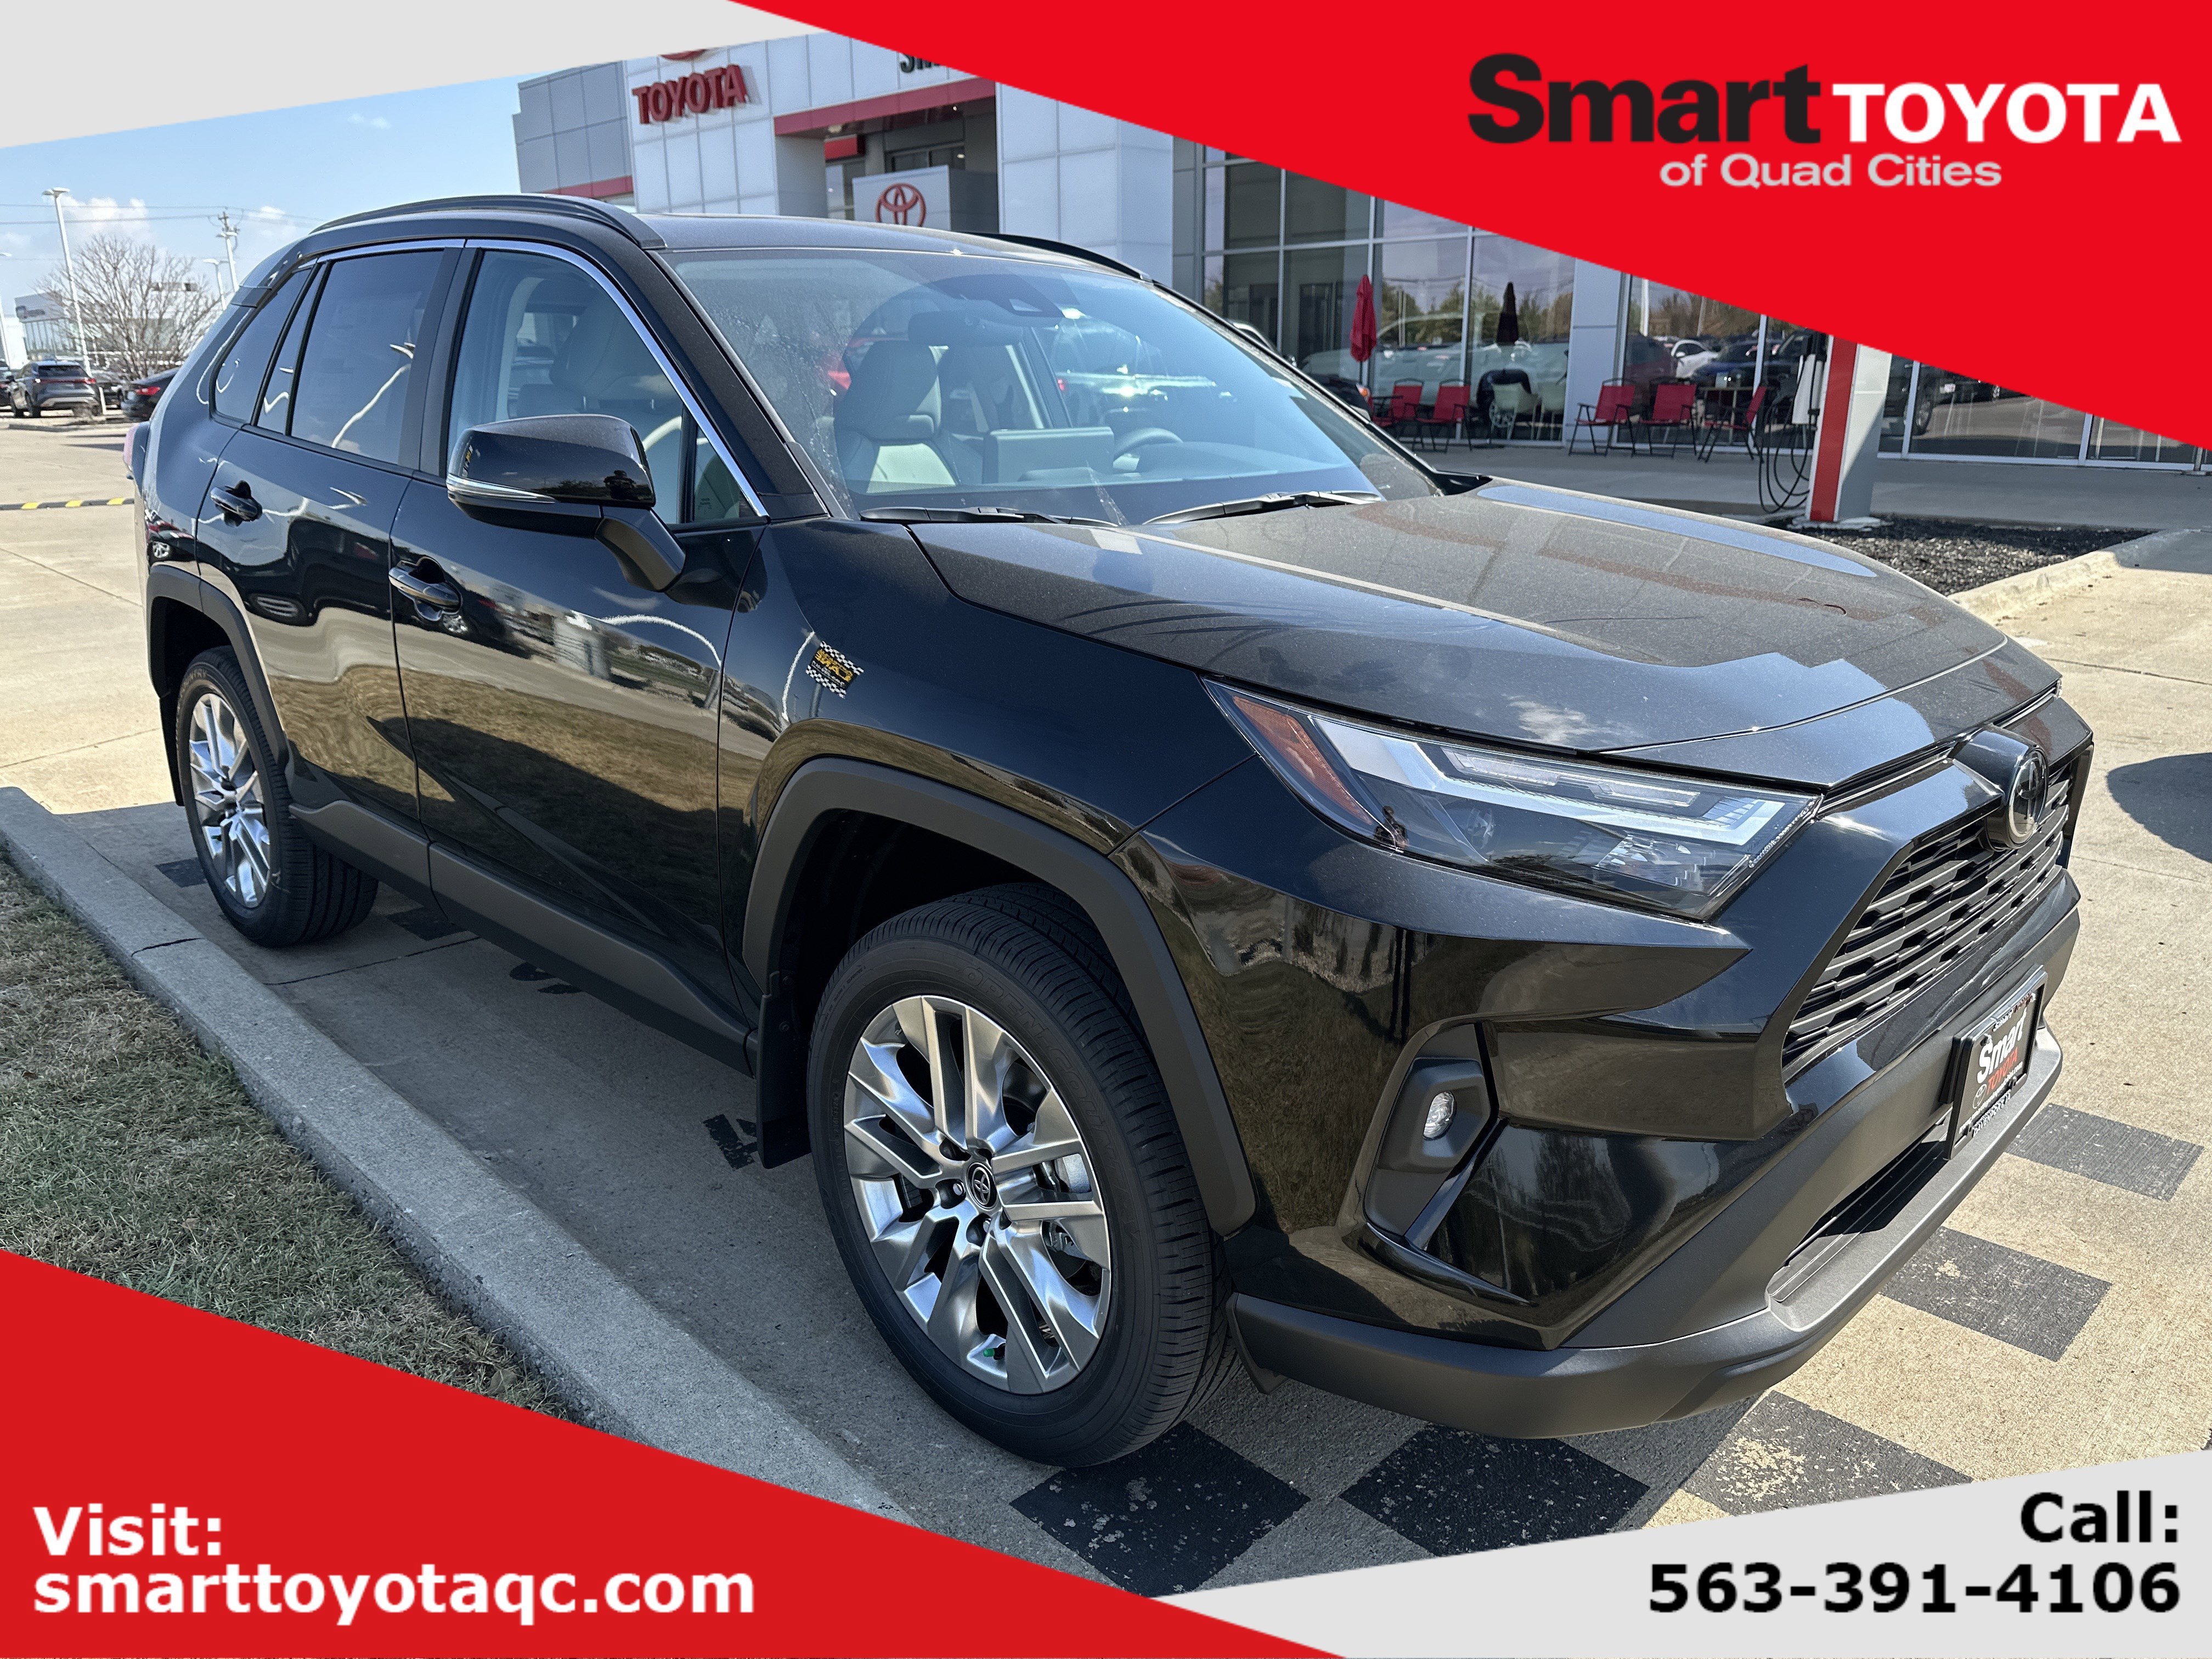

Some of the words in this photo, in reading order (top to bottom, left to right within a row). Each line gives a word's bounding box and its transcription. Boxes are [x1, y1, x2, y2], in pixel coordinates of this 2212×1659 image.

[632, 64, 747, 124] TOYOTA
[1977, 1006, 2027, 1084] Smart
[1986, 1046, 2018, 1096] TOYOTA
